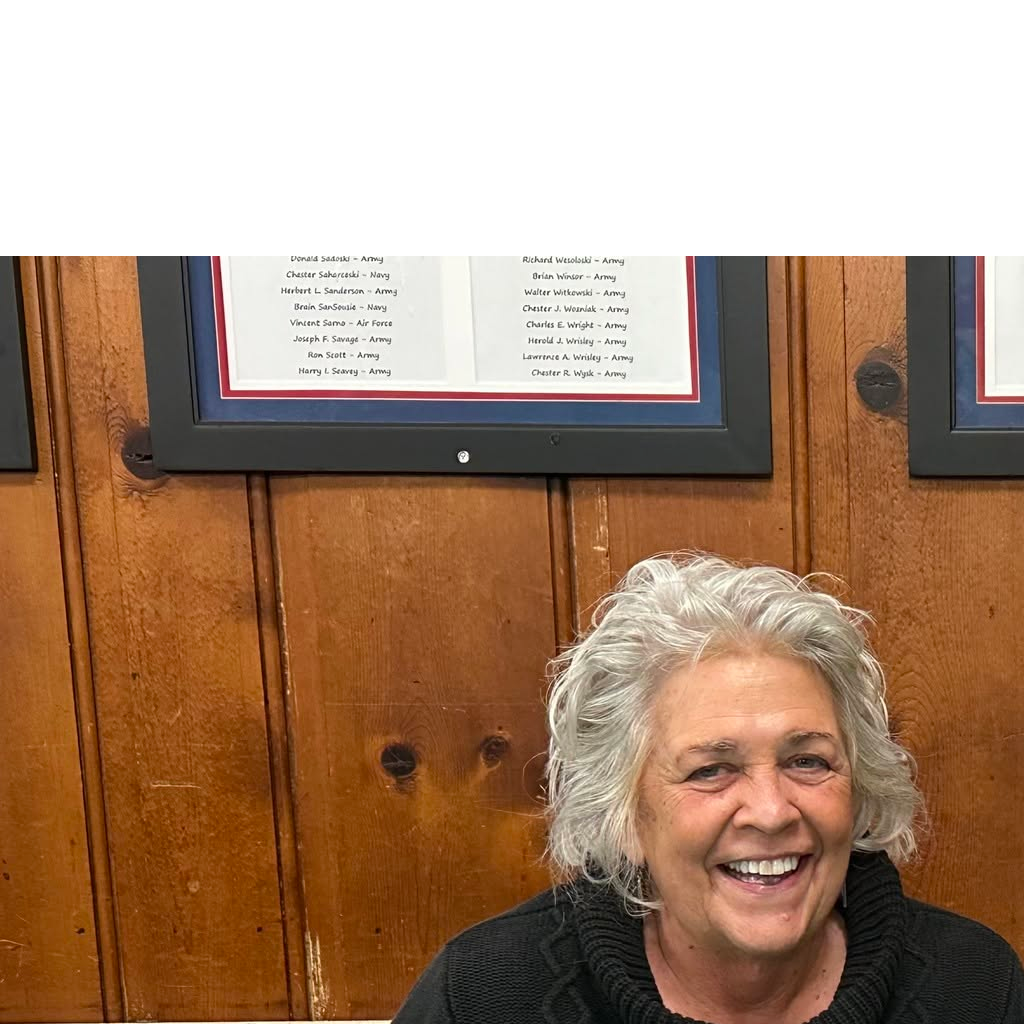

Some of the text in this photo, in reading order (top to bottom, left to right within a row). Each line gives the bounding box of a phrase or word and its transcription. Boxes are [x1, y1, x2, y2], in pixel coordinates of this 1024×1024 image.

[361, 256, 383, 264] Army
[370, 272, 390, 280] Navy
[557, 272, 584, 280] Winsor
[594, 274, 616, 282] Army
[375, 288, 397, 296] Army
[524, 288, 551, 296] Walter
[603, 290, 626, 298] Army
[367, 304, 387, 312] Navy
[607, 306, 629, 315] Army
[567, 321, 594, 330] Wright
[605, 322, 627, 331] Army
[293, 335, 320, 344] Joseph
[332, 336, 359, 344] Savage
[369, 336, 392, 345] Army
[566, 337, 594, 346] Wrisley
[605, 338, 627, 347] Army
[357, 352, 379, 361] Army
[573, 354, 601, 363] Wrisley
[611, 354, 633, 363] Army
[299, 368, 322, 376] Harry
[332, 368, 358, 376] Seavey
[369, 368, 391, 376] Army
[604, 370, 626, 379] Army
